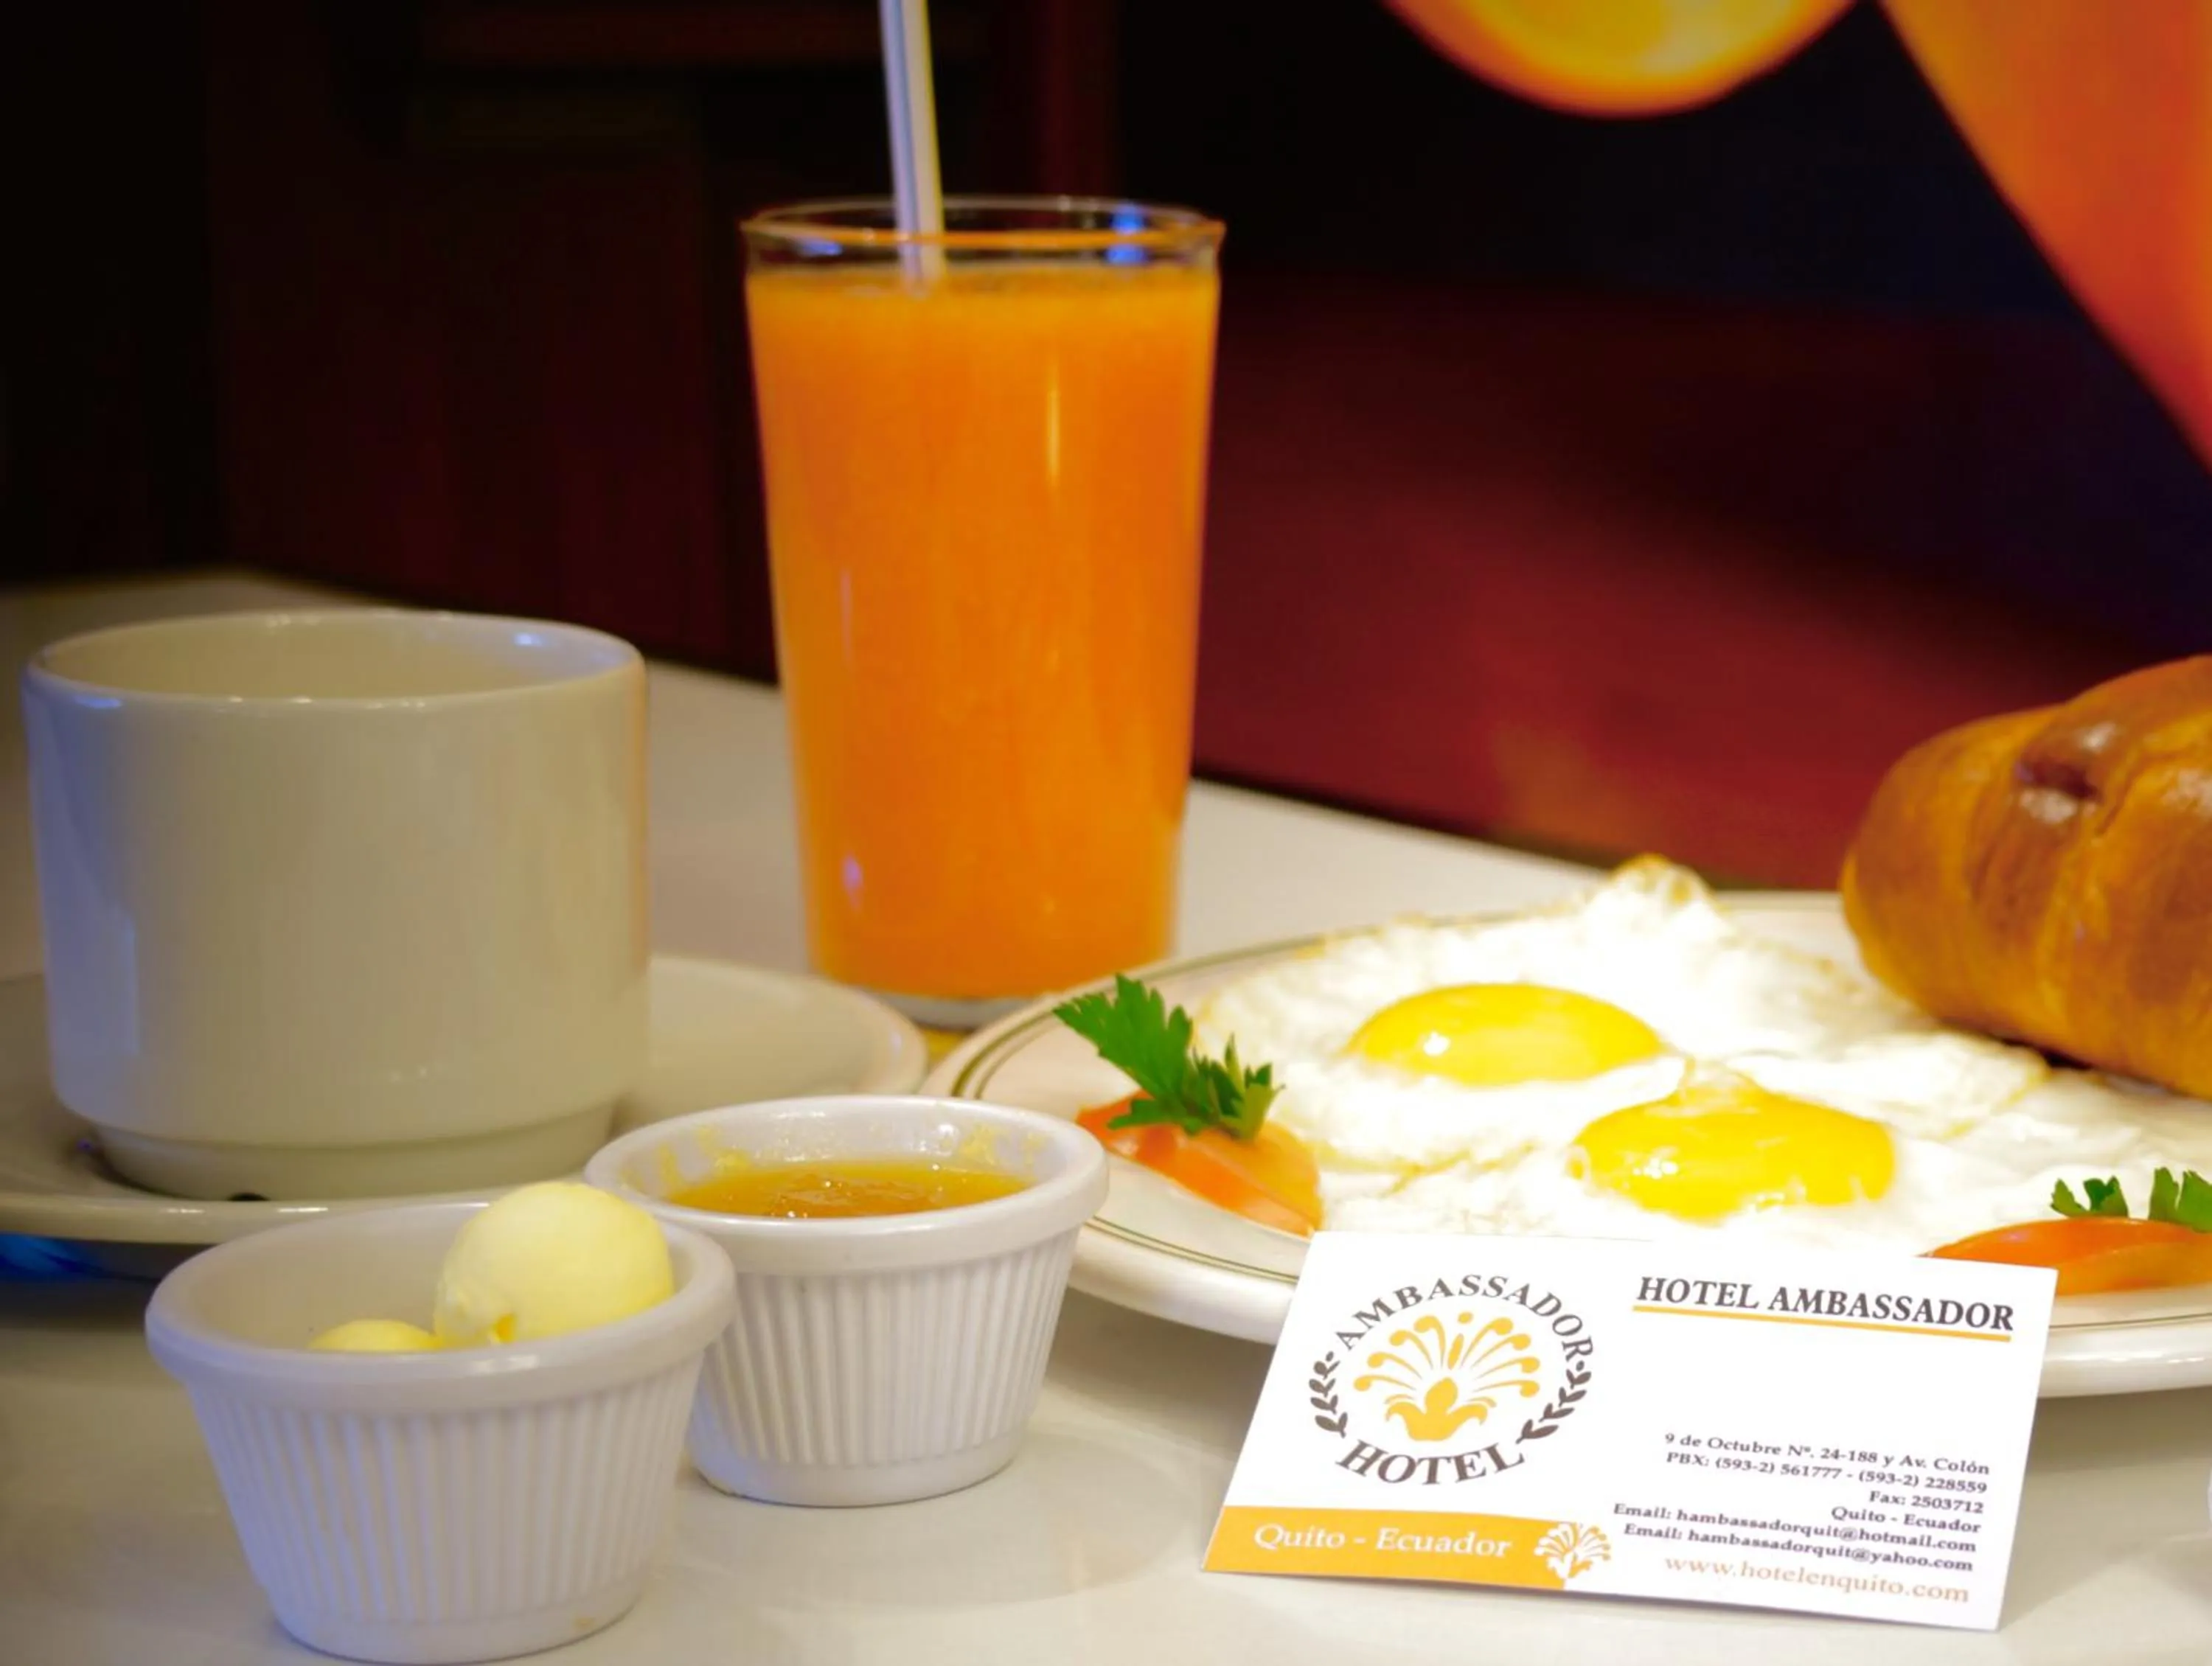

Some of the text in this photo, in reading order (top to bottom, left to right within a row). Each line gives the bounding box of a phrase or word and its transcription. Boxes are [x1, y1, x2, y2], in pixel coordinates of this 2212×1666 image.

[1335, 1275, 1594, 1361] AMBASSADOR
[1636, 1276, 2014, 1331] HOTEL AMBASSADOR
[1335, 1439, 1526, 1485] HOTEL
[1664, 1433, 1675, 1445] 9
[1680, 1435, 1702, 1447] de
[1707, 1437, 1782, 1455] Octubre
[1820, 1447, 1878, 1463] 24-188
[1882, 1455, 1894, 1468] y
[1899, 1454, 1927, 1468] Av.
[1933, 1457, 1990, 1475] Colón
[1666, 1451, 1710, 1467] PBX:
[1714, 1457, 1775, 1474] (593-2)
[1780, 1463, 1843, 1479] 561777
[1859, 1470, 1920, 1488] (593-2)
[1924, 1477, 1988, 1494] 228559
[1831, 1506, 1886, 1523] Quito
[1903, 1513, 1982, 1533] Ecuador
[1869, 1490, 1985, 1514] Fax: 2503712
[1253, 1523, 1346, 1551] Quito
[1375, 1526, 1512, 1558] Ecuador
[1613, 1502, 1977, 1552] Email: hambassadorquit@hotmail.com
[1624, 1522, 1974, 1572] Email: hambassadorquit@yahoo.com
[1664, 1558, 1969, 1603] www.hotelenquito.com
